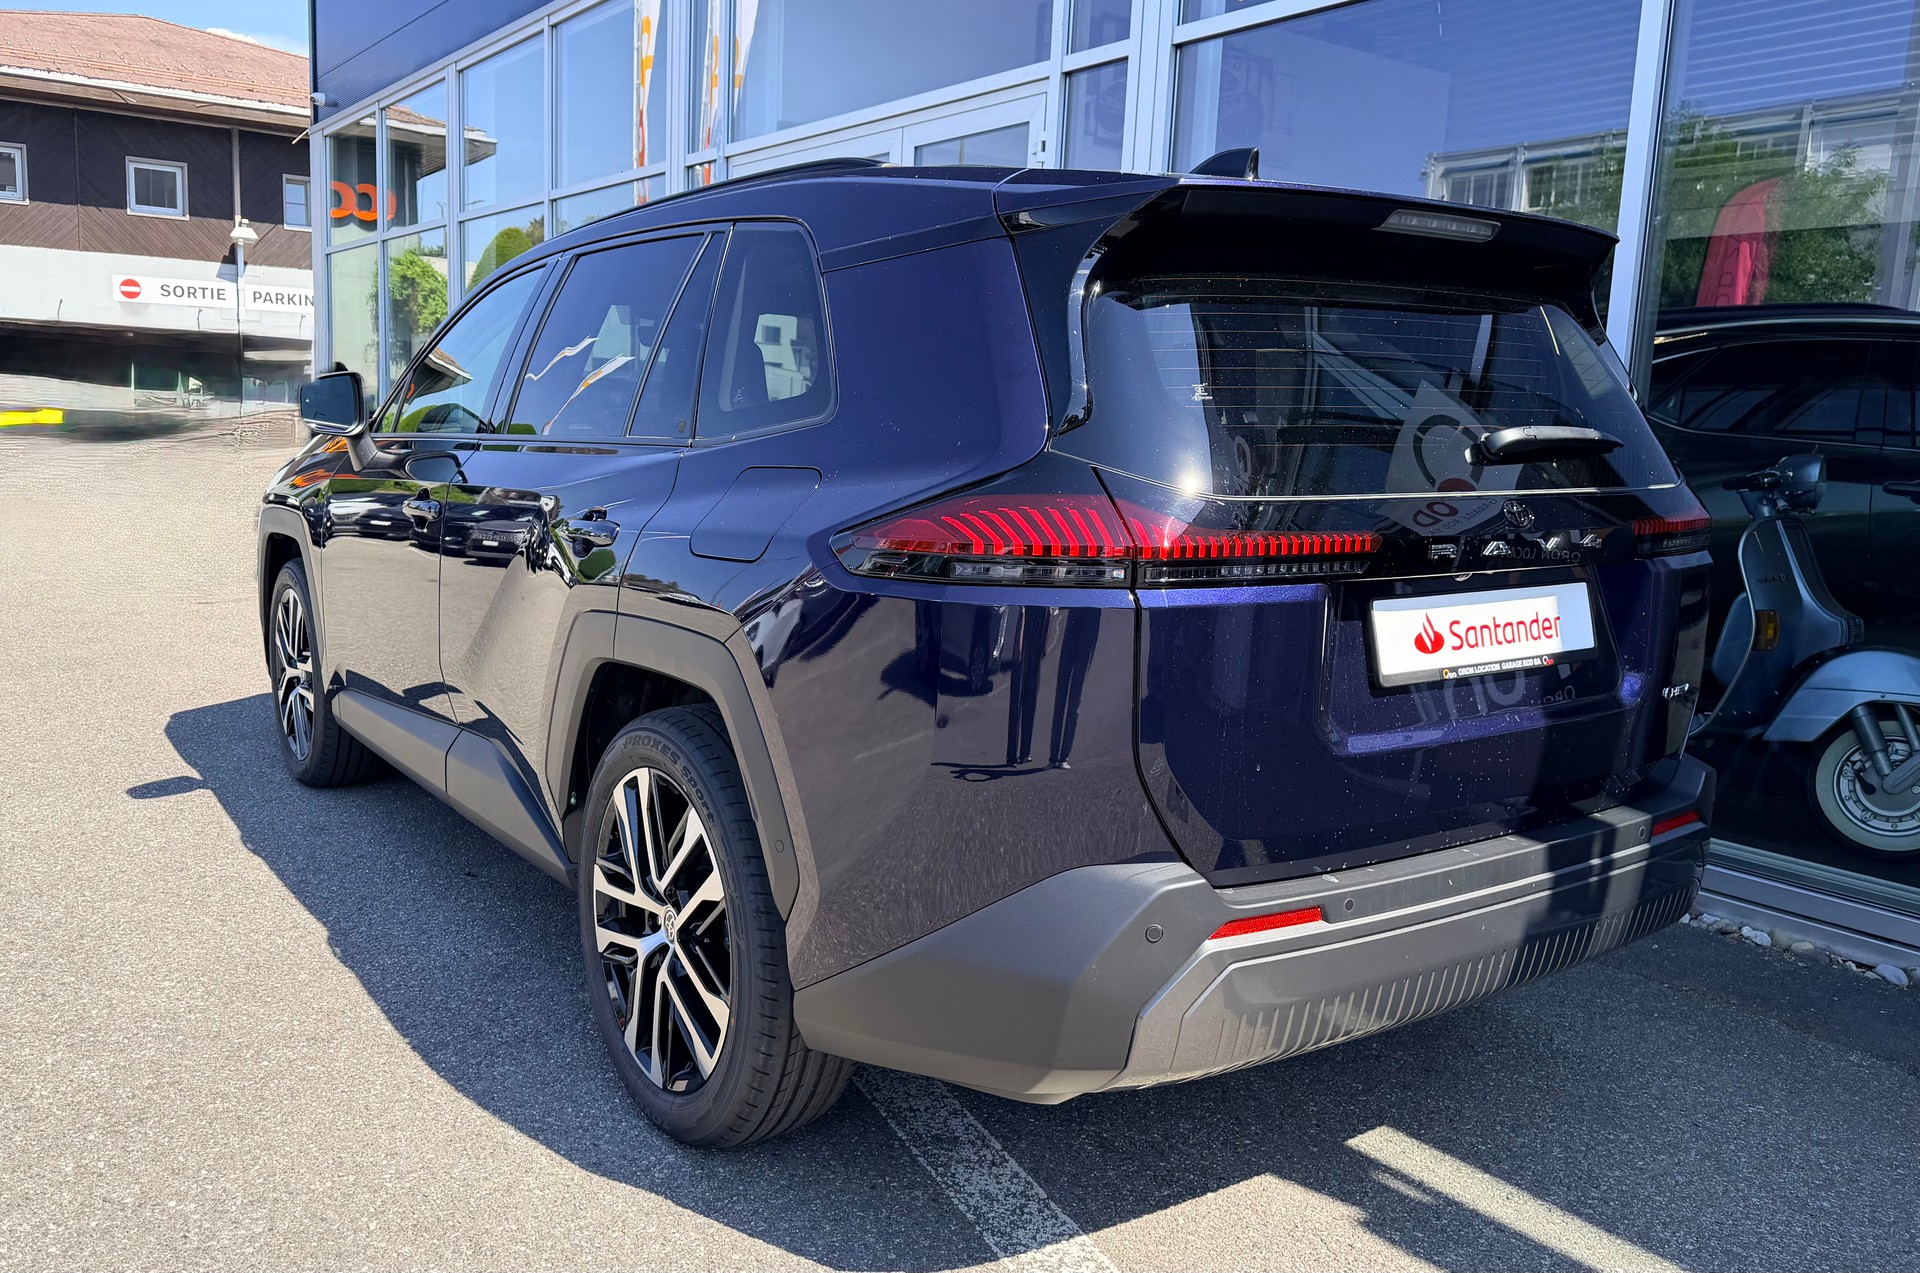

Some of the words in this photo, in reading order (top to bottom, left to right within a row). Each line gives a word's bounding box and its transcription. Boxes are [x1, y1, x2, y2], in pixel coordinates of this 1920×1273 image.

[160, 284, 226, 301] SORTIE
[1448, 612, 1561, 651] Santander
[1475, 662, 1501, 674] LOCATION
[1501, 660, 1523, 670] GARAGE
[623, 735, 680, 765] PROXES
